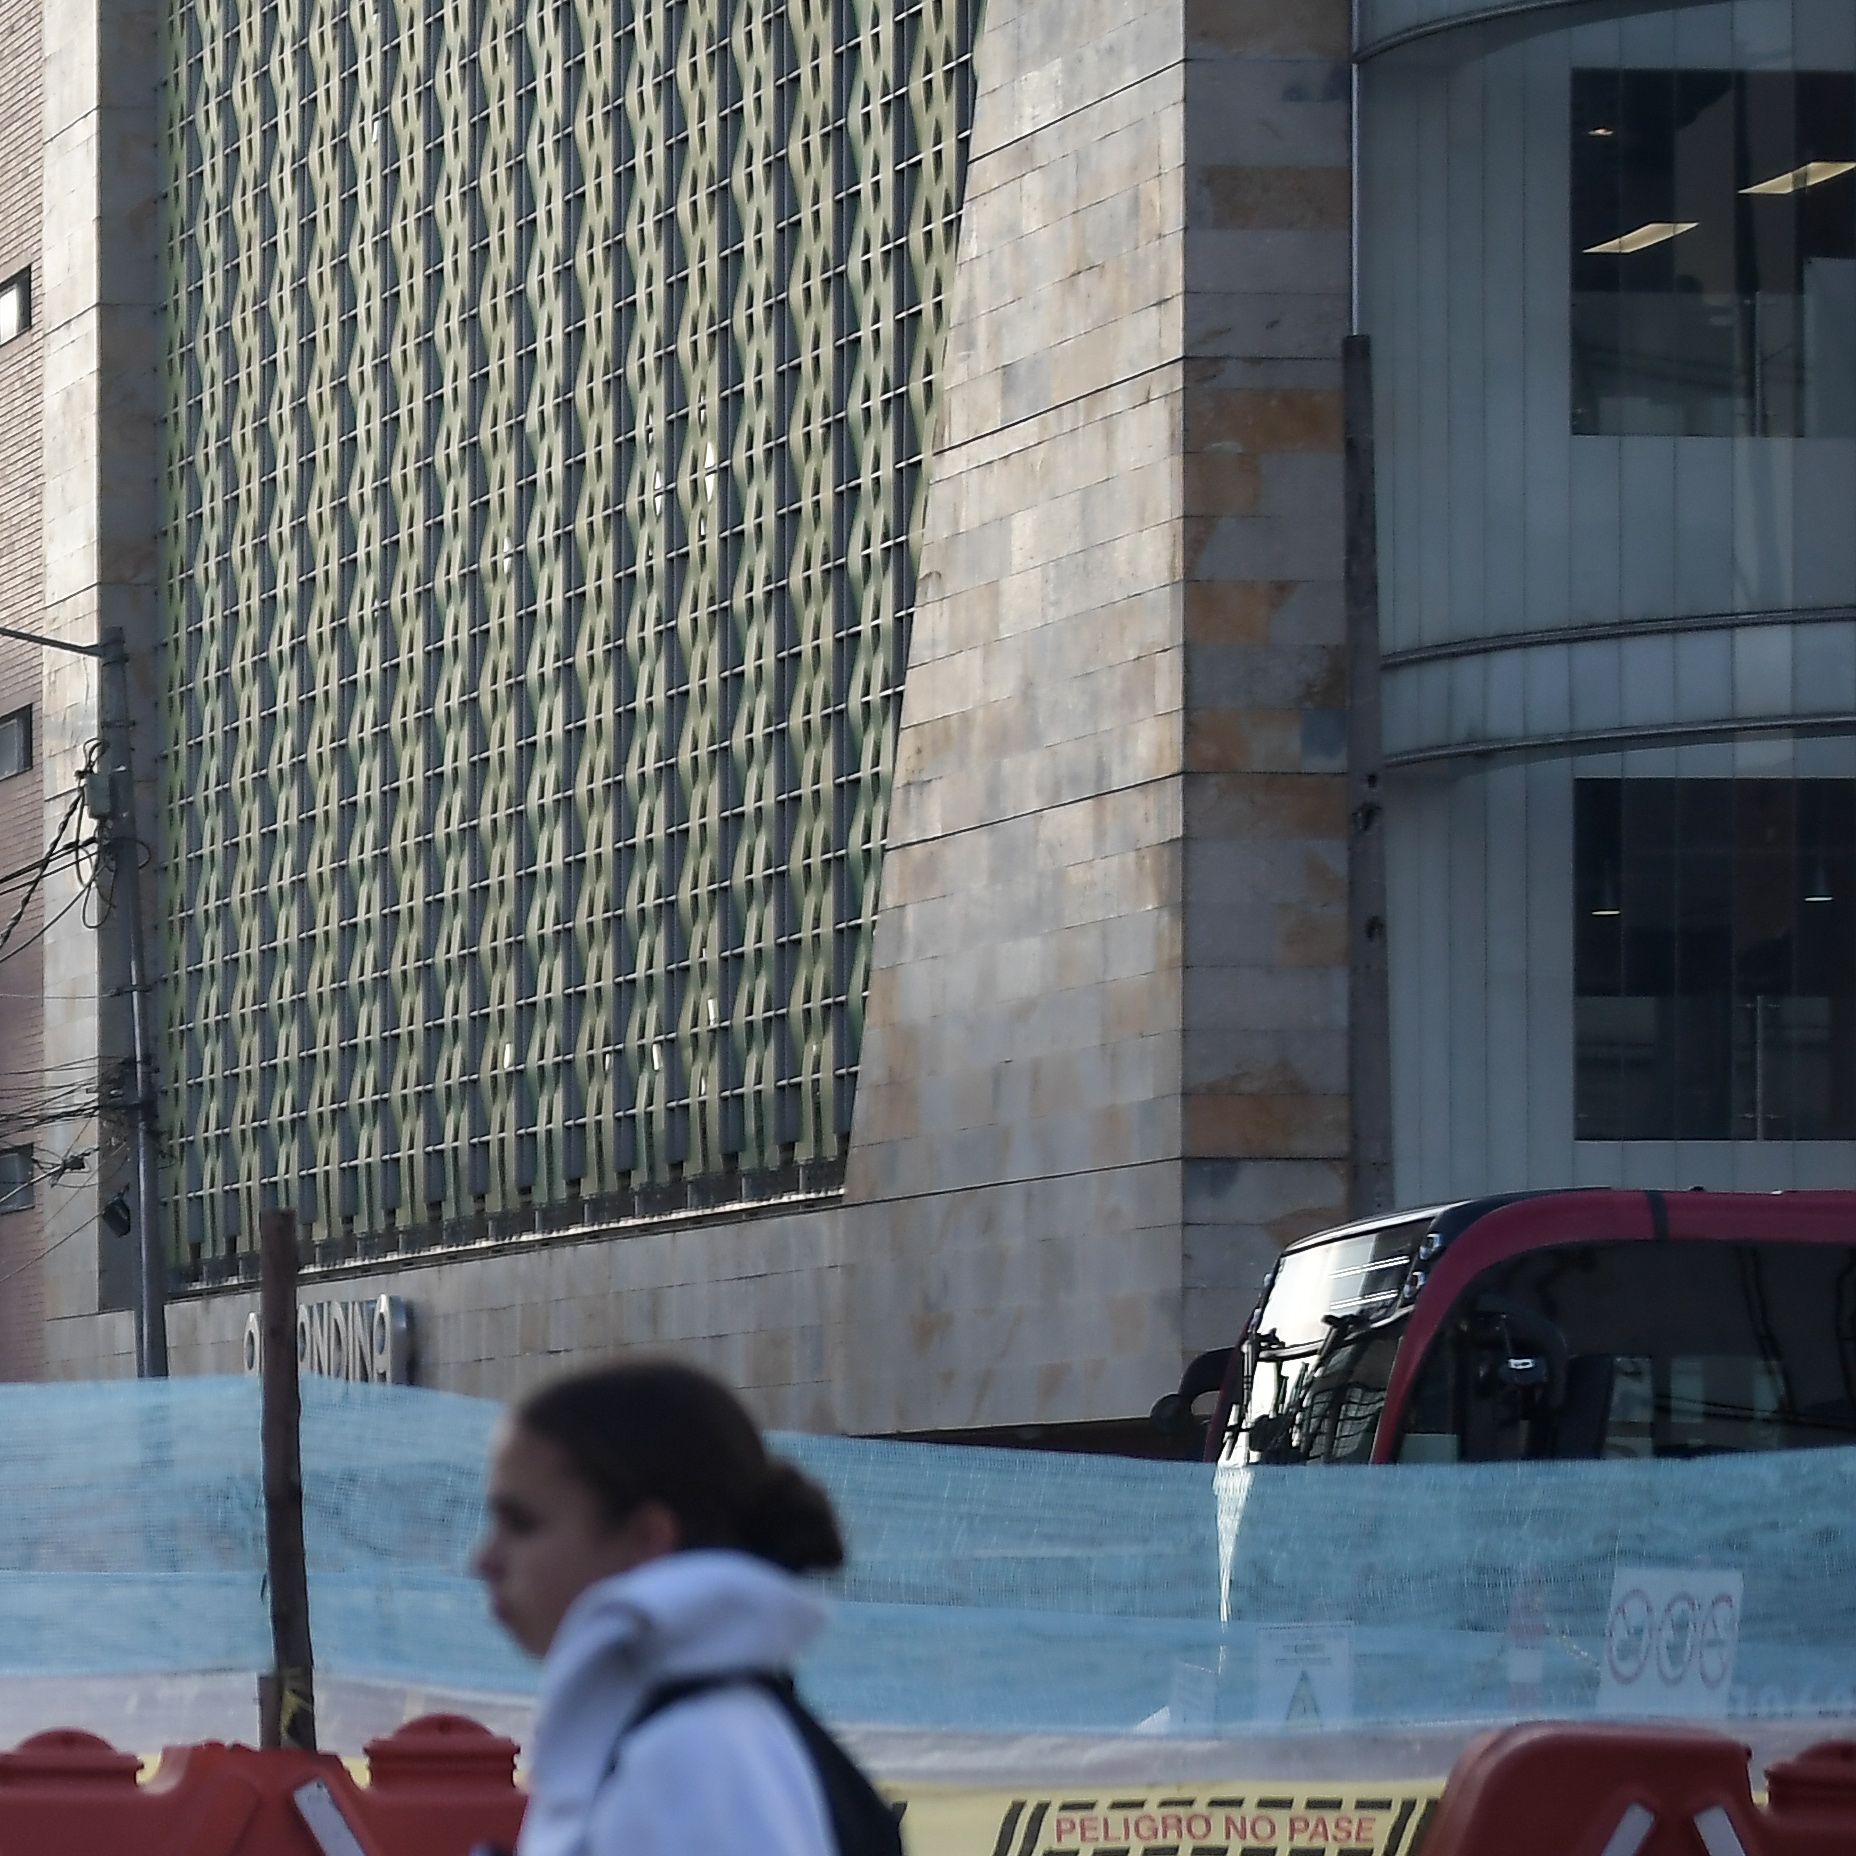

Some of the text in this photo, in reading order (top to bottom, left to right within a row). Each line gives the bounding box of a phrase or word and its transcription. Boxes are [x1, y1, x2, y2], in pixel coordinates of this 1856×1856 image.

[1055, 1813, 1378, 1844] PELIGRO NO PASE
